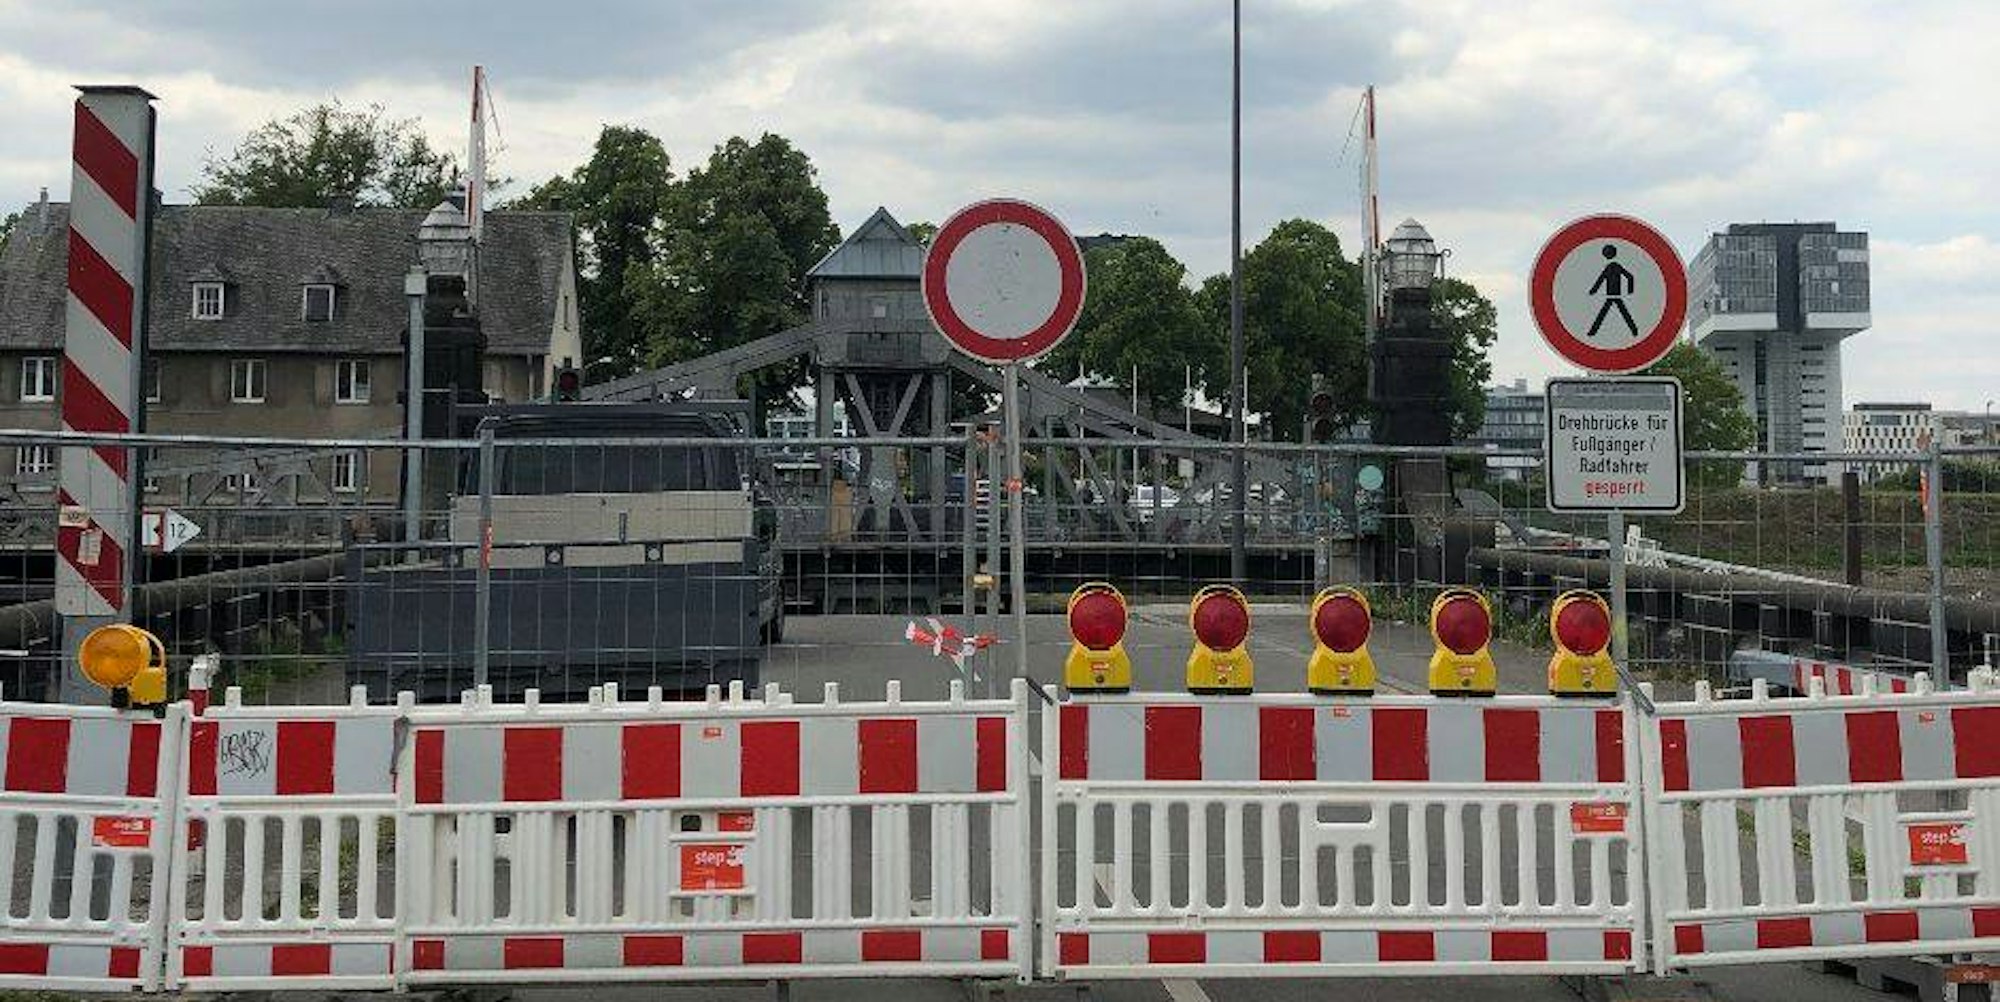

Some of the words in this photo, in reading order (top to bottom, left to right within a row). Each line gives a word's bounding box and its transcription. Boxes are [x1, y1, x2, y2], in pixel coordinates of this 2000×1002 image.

[1558, 414, 1639, 430] Drehbrücke
[1647, 414, 1668, 430] für
[1572, 436, 1645, 455] Fußgänger
[1579, 457, 1649, 474] Radfahrer
[1585, 481, 1646, 498] gesperrt
[169, 523, 187, 539] 12
[1922, 831, 1949, 846] step
[694, 850, 725, 867] step
